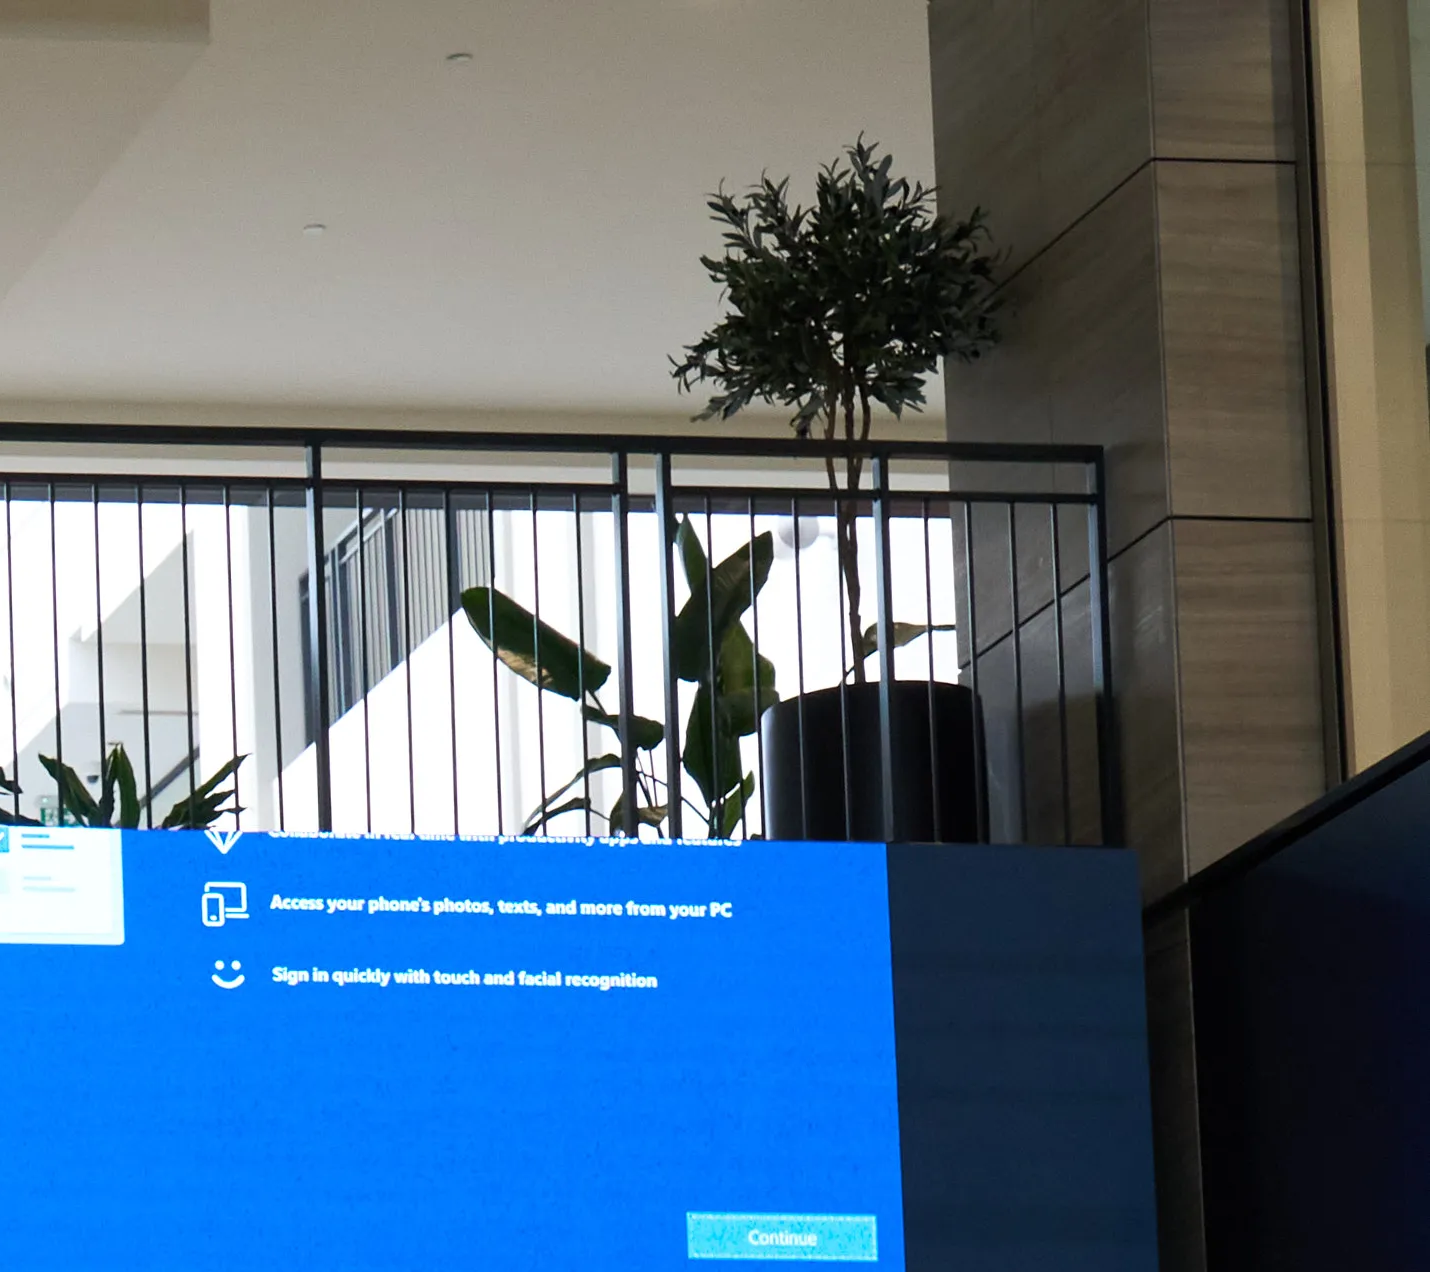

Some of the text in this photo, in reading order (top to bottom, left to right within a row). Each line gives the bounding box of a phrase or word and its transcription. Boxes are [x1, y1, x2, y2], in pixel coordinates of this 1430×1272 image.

[269, 894, 733, 920] Access your phone's photos, texts, and more from your PC
[272, 966, 658, 991] Sign in quickly with touch and facial recognition
[748, 1229, 818, 1246] Continue
